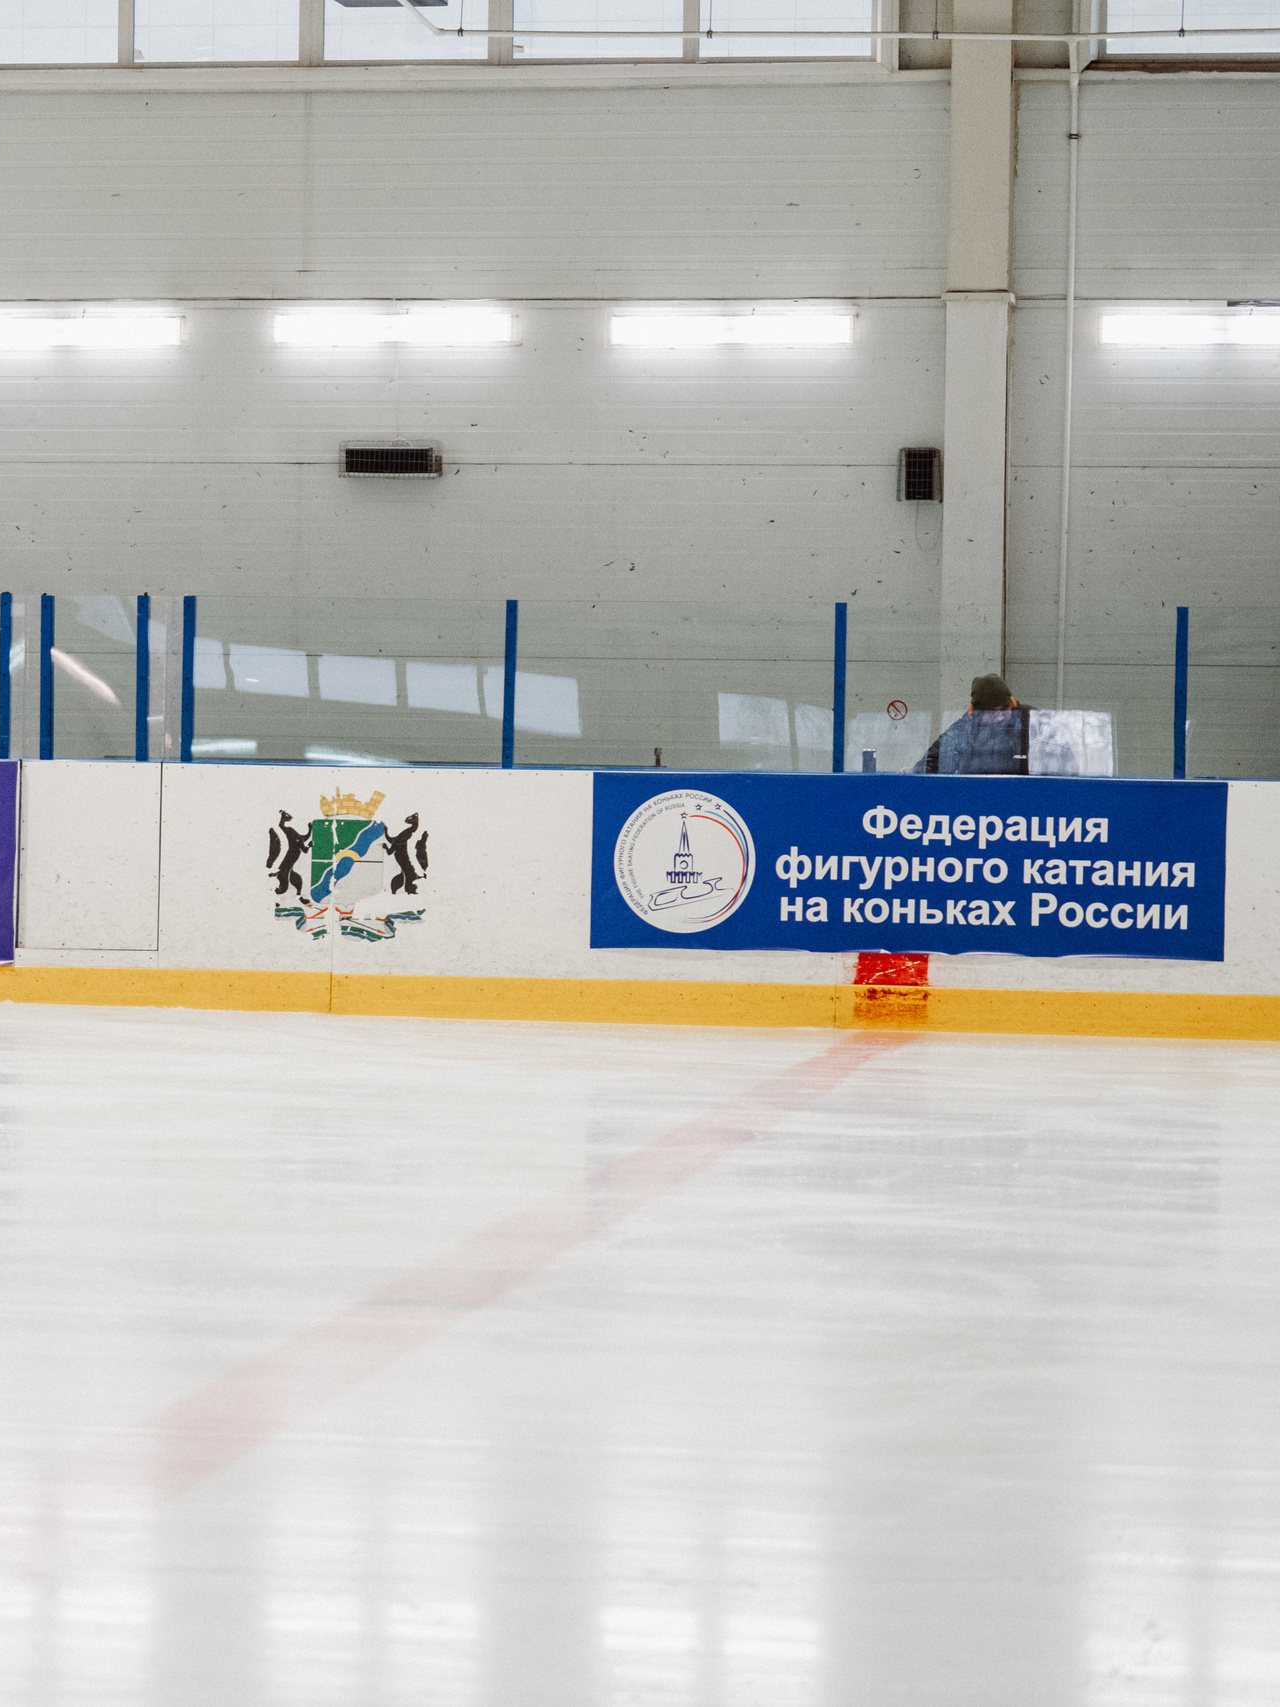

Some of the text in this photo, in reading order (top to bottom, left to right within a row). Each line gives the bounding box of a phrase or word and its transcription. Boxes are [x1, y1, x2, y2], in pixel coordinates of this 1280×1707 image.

[623, 811, 643, 838] КАТАНИЯ
[643, 804, 652, 813] НА
[653, 793, 683, 806] КОНЬКАХ
[685, 792, 713, 804] РОССИИ
[665, 803, 685, 811] RUSSIA
[862, 805, 1109, 848] Федерация
[775, 846, 1196, 890] фигурного катания
[780, 892, 1188, 930] на коньках России
